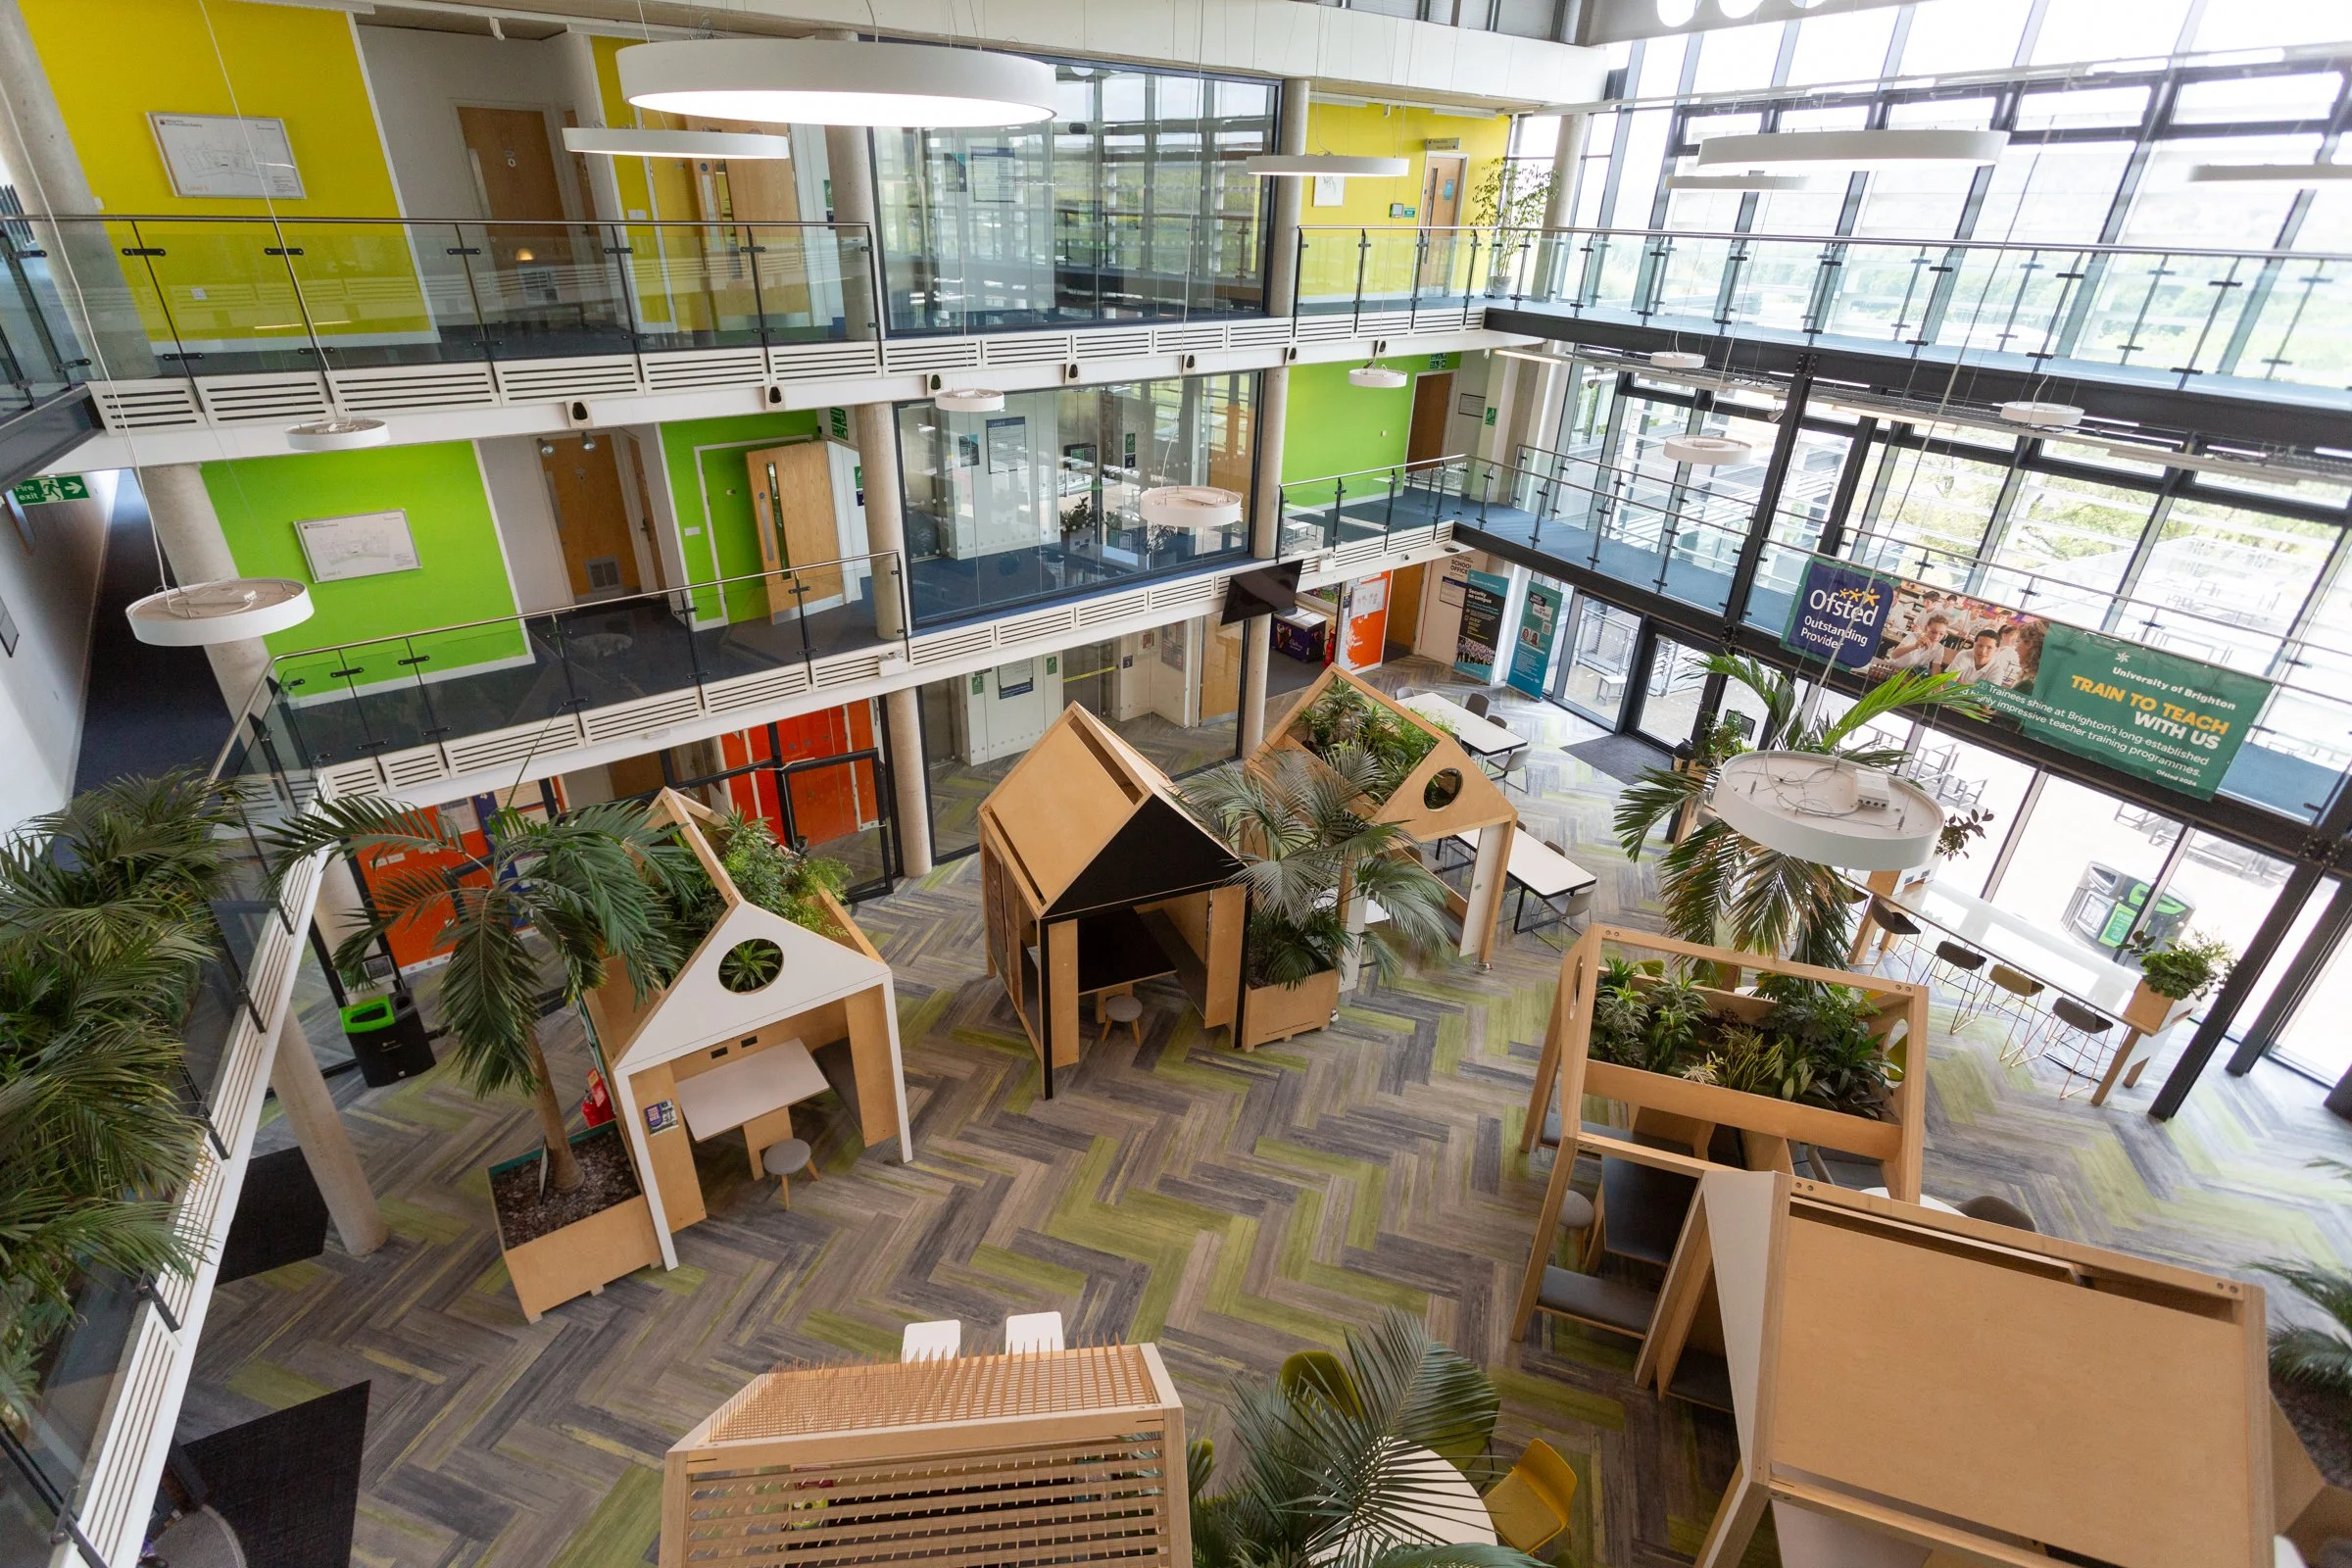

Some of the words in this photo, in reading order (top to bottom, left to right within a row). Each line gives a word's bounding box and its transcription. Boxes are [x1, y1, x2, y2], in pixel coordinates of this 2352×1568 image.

[1809, 589, 1880, 627] Ofsted
[1804, 615, 1868, 647] Outstanding
[2071, 674, 2127, 703] TRAIN
[2129, 692, 2157, 711] TO
[2162, 702, 2231, 735] TEACH
[2112, 666, 2169, 692] University
[2170, 684, 2183, 695] of
[2183, 688, 2236, 710] Brighton
[1988, 684, 2026, 705] Trainees
[2027, 699, 2053, 713] shine
[2054, 708, 2066, 717] at
[2068, 710, 2118, 735] Brighton's
[2118, 728, 2210, 766] long-established
[1997, 699, 2047, 723] impressive
[2048, 717, 2087, 737] teacher
[2087, 730, 2128, 753] training
[2128, 746, 2202, 778] programmes.
[2133, 710, 2187, 740] WITH
[2189, 729, 2222, 750] US
[2156, 768, 2179, 781] Ofsted
[2179, 775, 2198, 787] 2024
